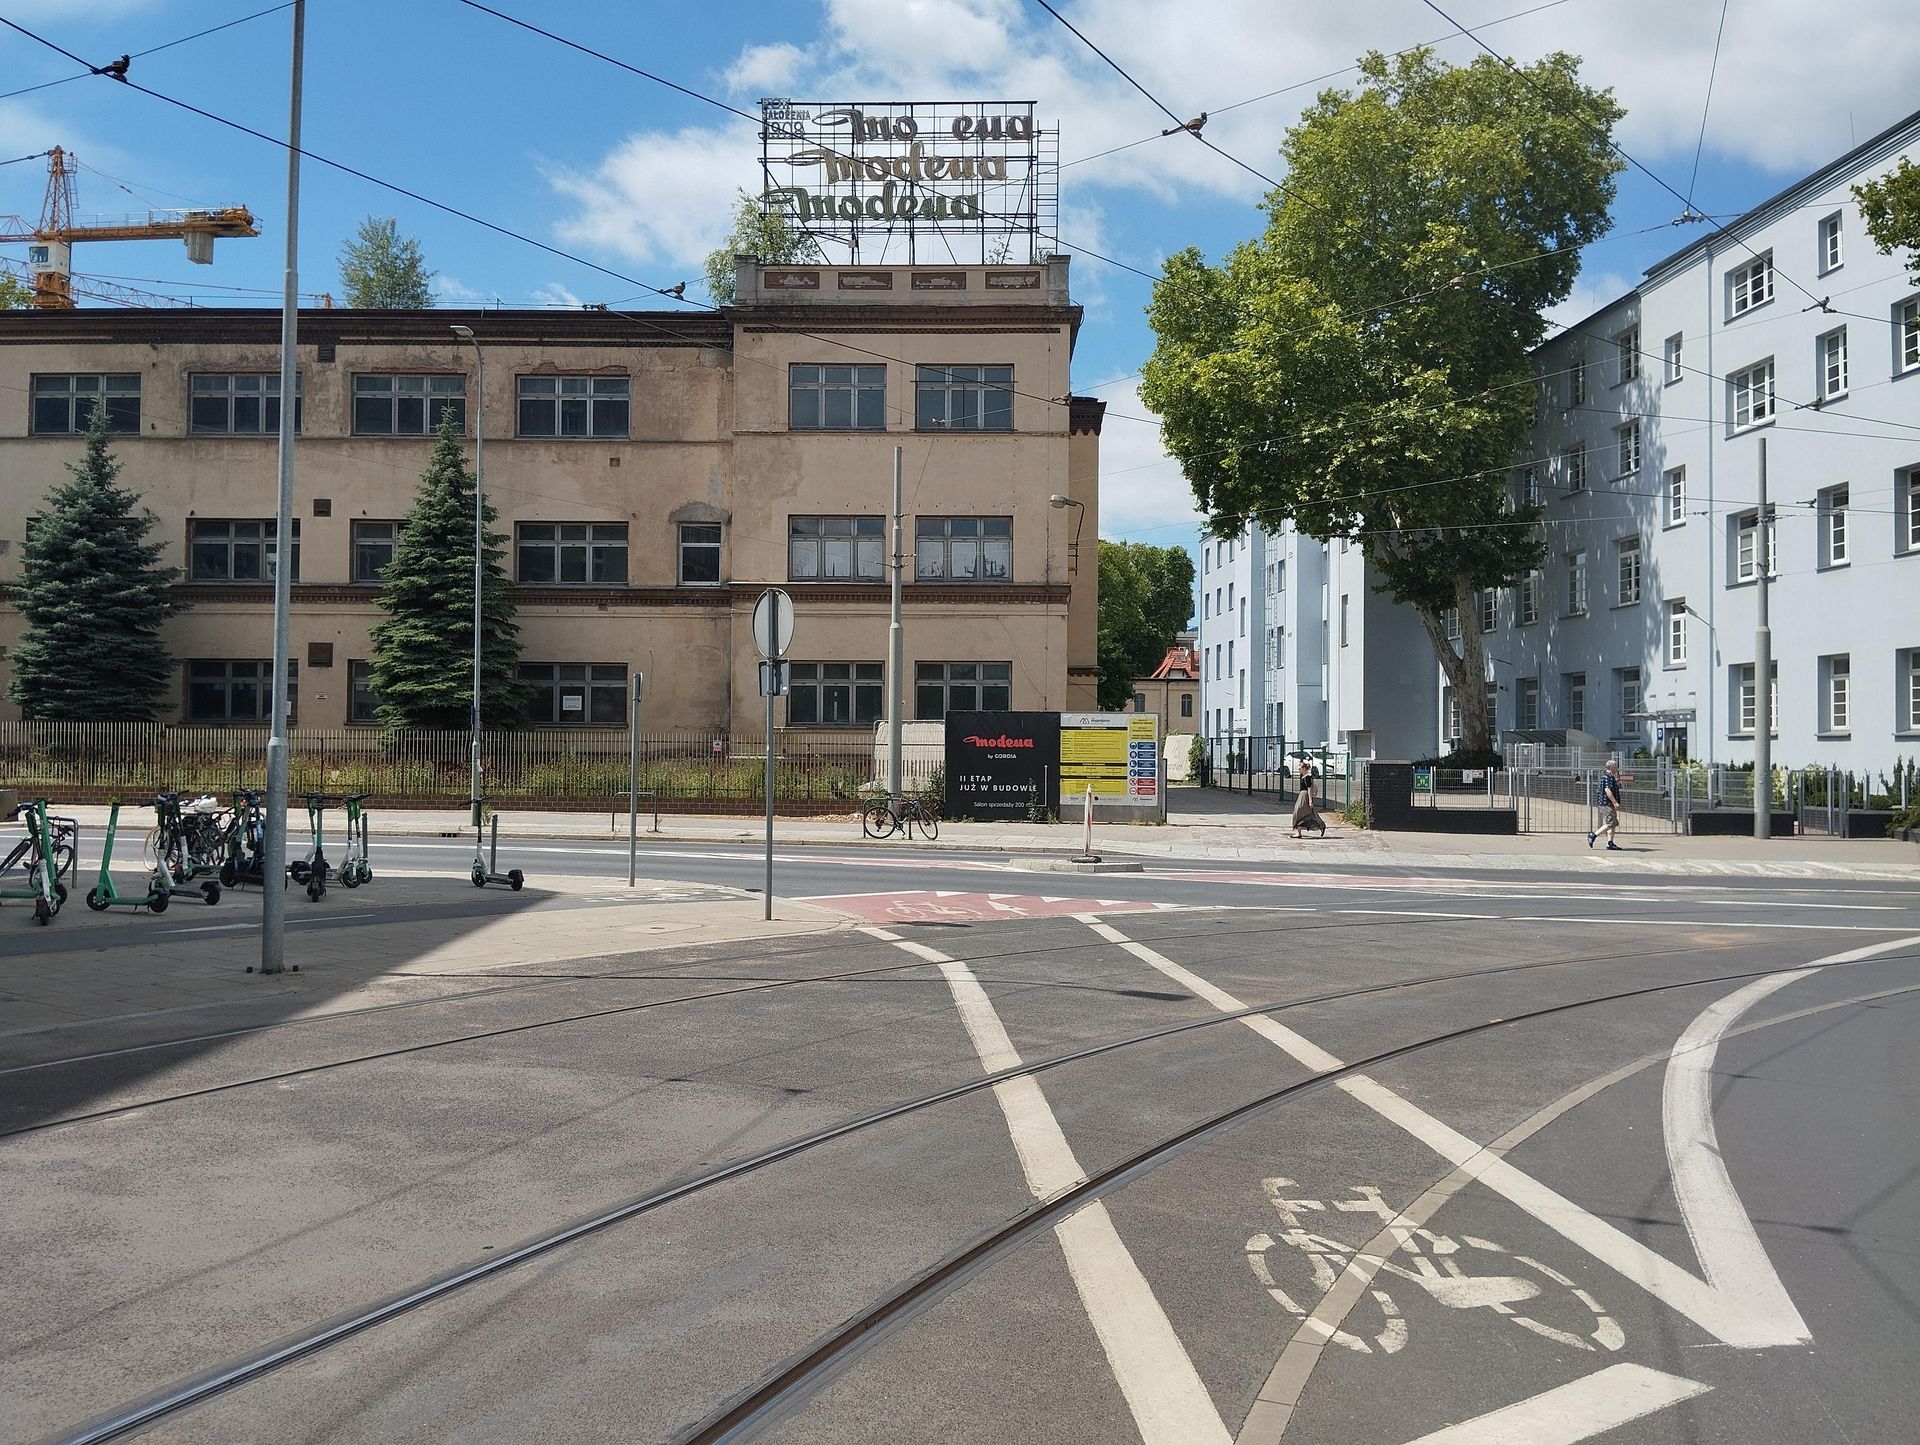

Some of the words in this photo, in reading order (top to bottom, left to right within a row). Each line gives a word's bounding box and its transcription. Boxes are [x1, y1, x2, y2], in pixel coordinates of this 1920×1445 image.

[959, 783, 977, 791] JUŻ
[993, 784, 1037, 792] BUDOWIE
[988, 801, 1015, 809] sprzedaży
